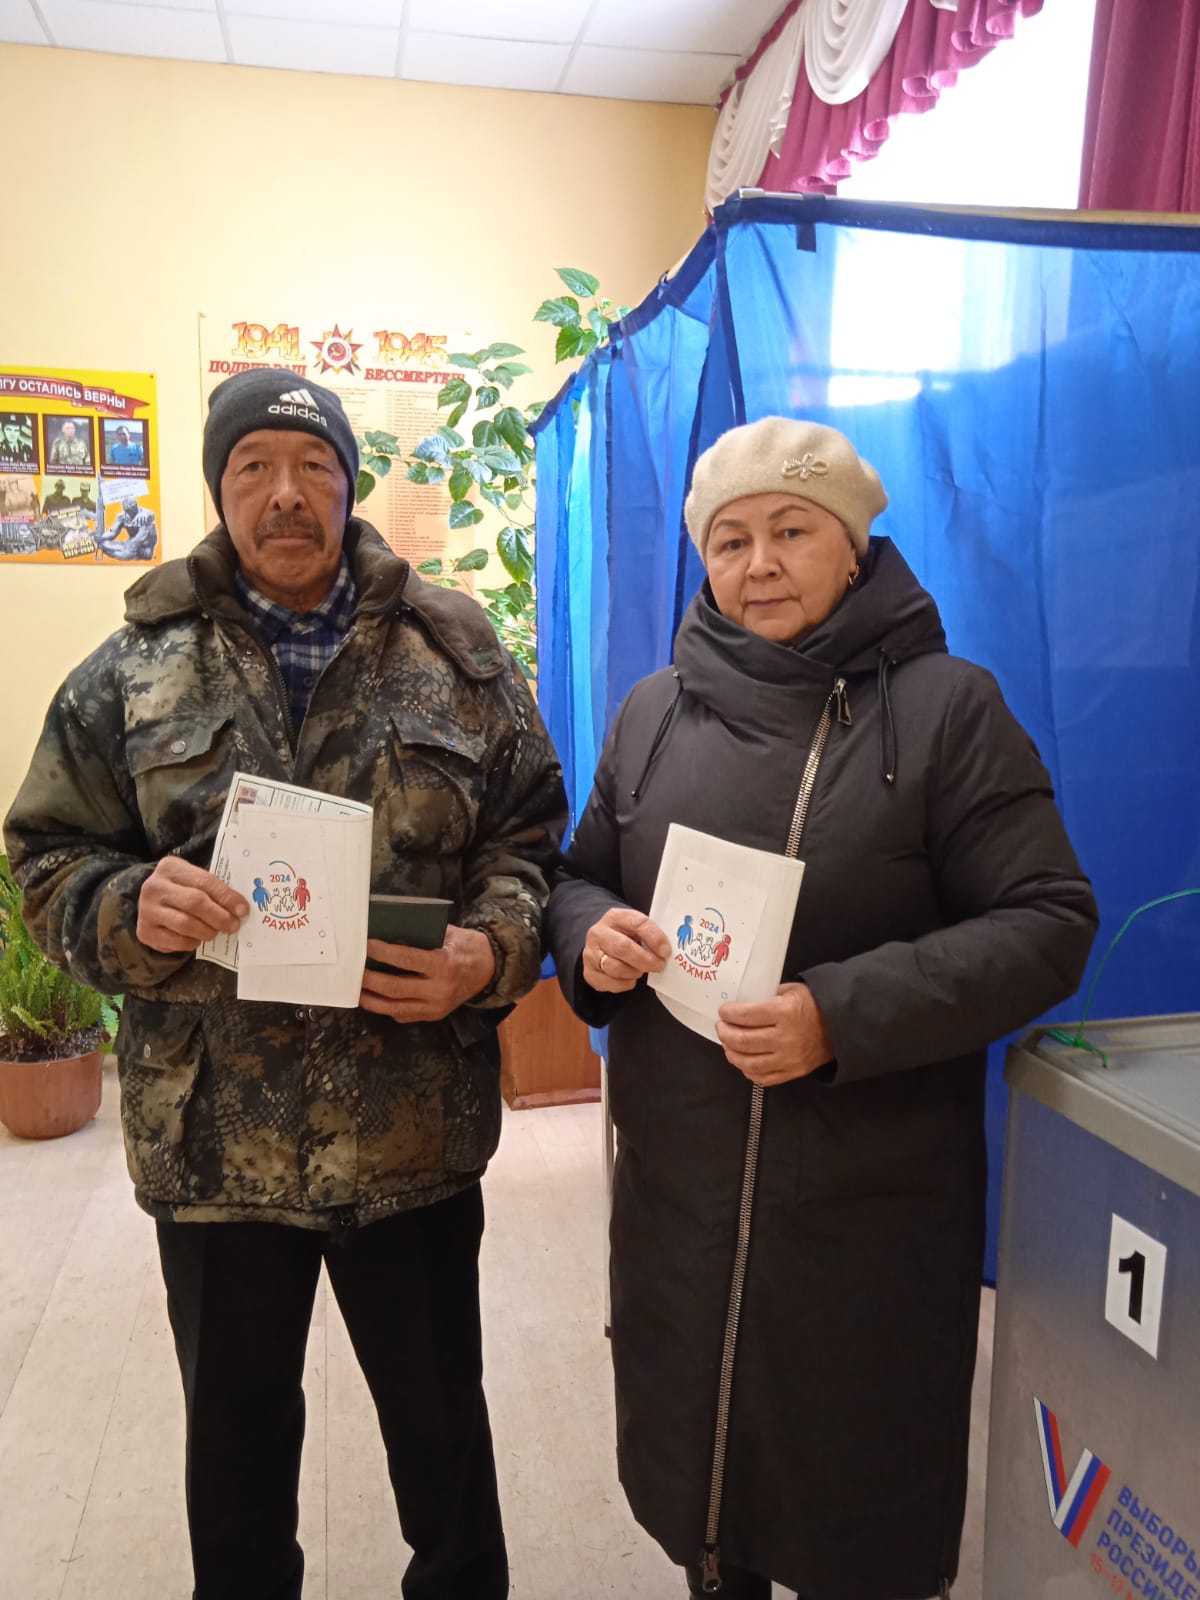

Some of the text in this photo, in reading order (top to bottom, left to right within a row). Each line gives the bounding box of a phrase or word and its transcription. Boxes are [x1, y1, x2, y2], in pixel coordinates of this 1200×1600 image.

[232, 322, 300, 360] 1941
[374, 330, 449, 369] 1945
[208, 360, 266, 376] ПОДВ
[0, 378, 126, 409] ГУ ОСТАЛИСЬ ВЕРНЫ
[268, 404, 328, 427] adidas
[270, 874, 291, 883] 2024
[262, 914, 310, 931] РАХМАТ
[699, 918, 719, 934] 2024
[675, 953, 718, 981] РАХМАТ
[1118, 1249, 1146, 1326] 1
[1107, 1508, 1200, 1600] ПРЕЗИДЕ
